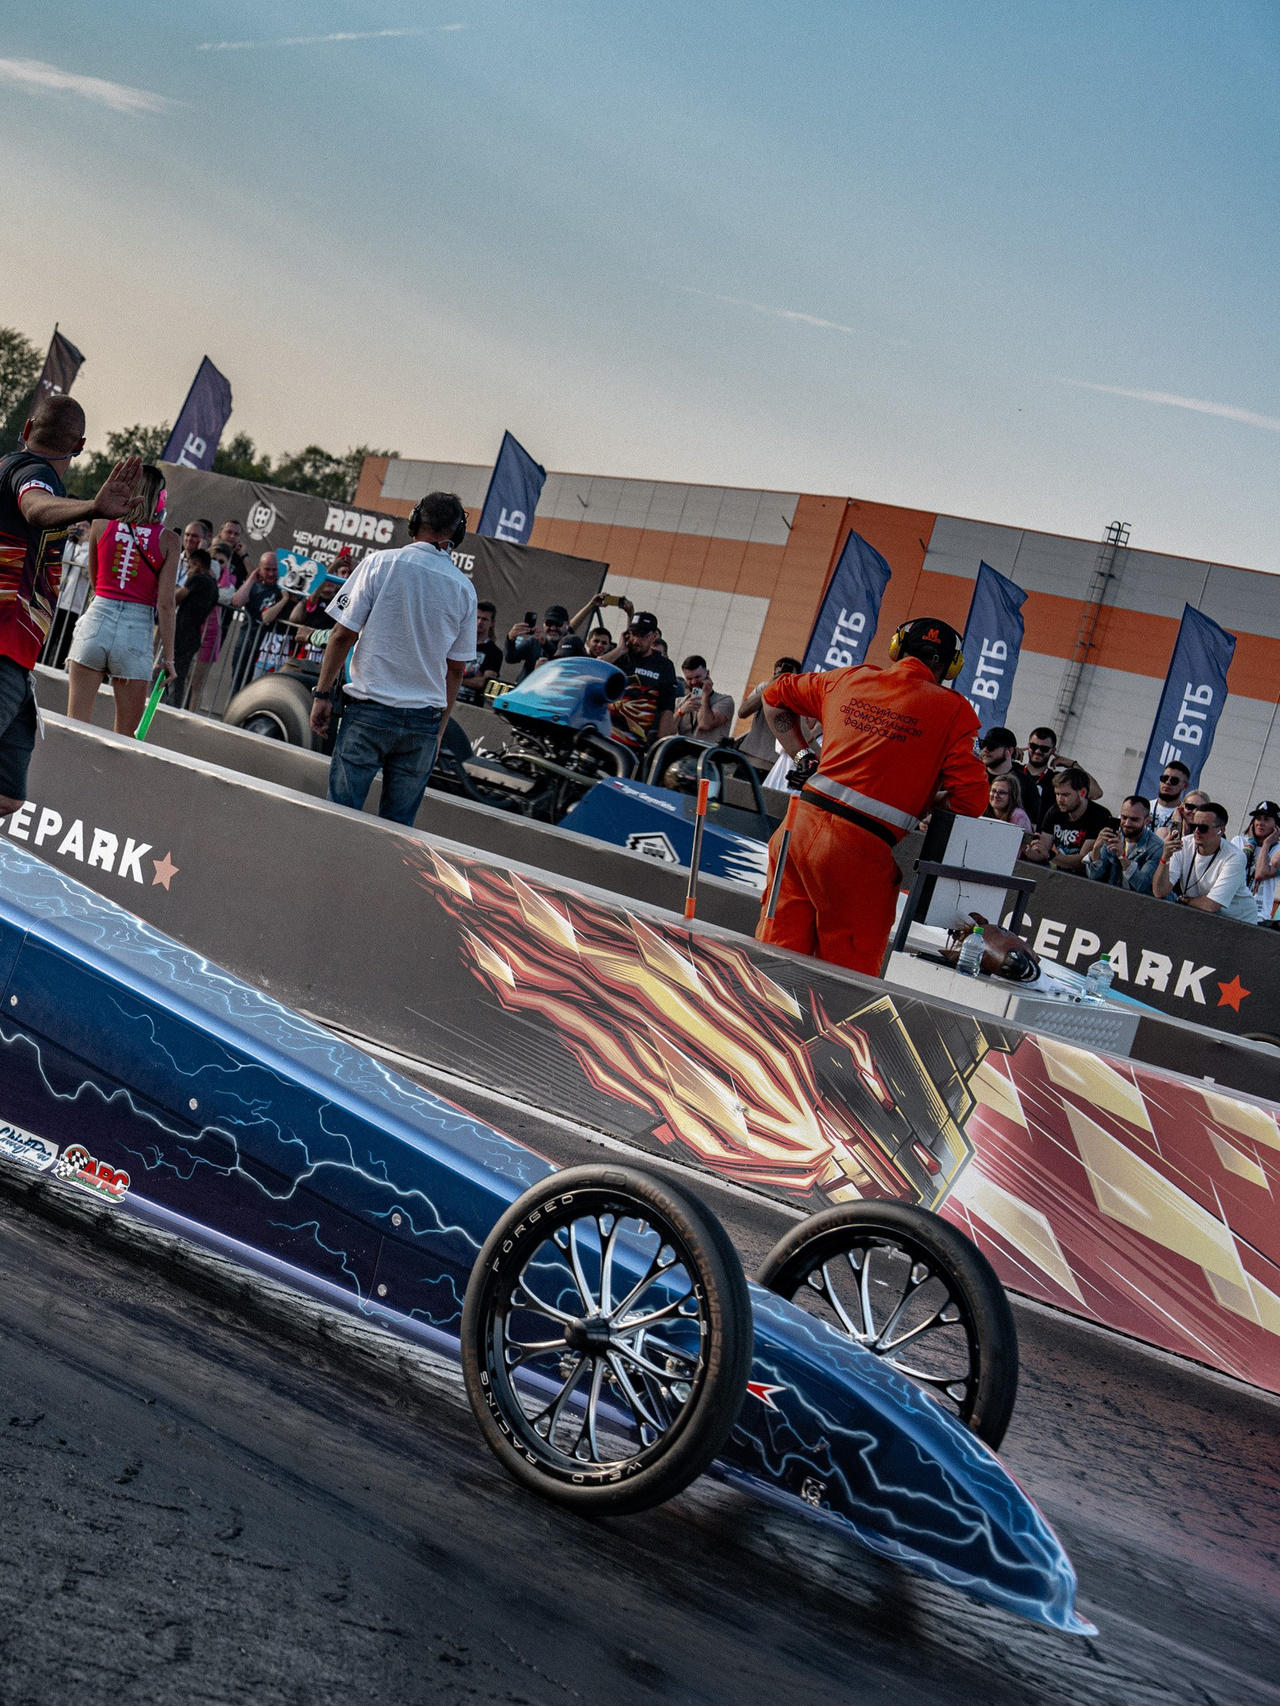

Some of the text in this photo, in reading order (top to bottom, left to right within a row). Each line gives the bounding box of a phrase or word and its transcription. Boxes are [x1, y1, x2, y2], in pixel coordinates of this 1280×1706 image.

[324, 506, 395, 544] RDRC
[824, 607, 867, 669] ВТБ
[971, 637, 1008, 701] ВТБ
[839, 704, 923, 739] автомобильная
[843, 716, 908, 744] федерация
[848, 697, 918, 727] российская
[1173, 682, 1214, 746] ВТБ
[492, 1194, 574, 1273] FORGED
[479, 1370, 538, 1465] RACING
[571, 1460, 643, 1484] WELD
